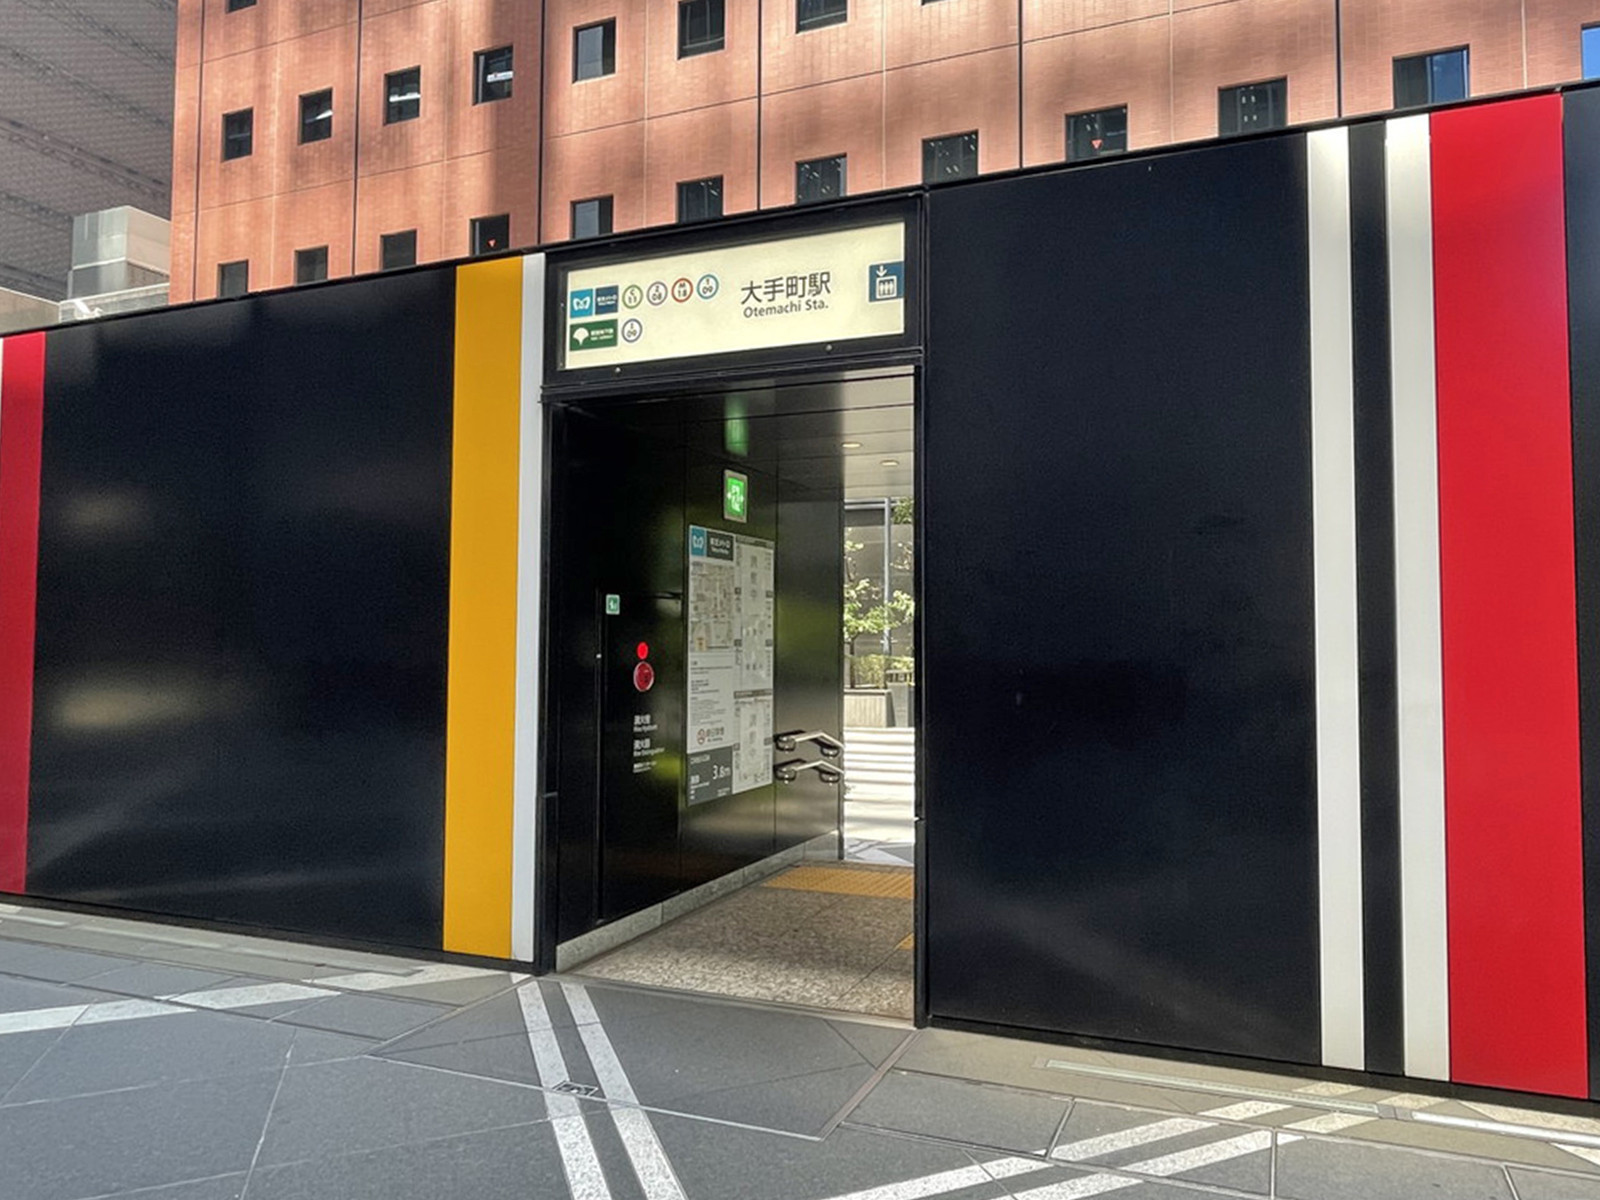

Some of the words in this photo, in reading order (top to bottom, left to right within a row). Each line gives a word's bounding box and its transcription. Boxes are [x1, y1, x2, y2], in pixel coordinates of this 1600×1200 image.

[702, 285, 713, 294] 09
[741, 271, 831, 305] 大手町駅
[743, 300, 801, 318] Otemachi
[805, 299, 829, 311] Sta.
